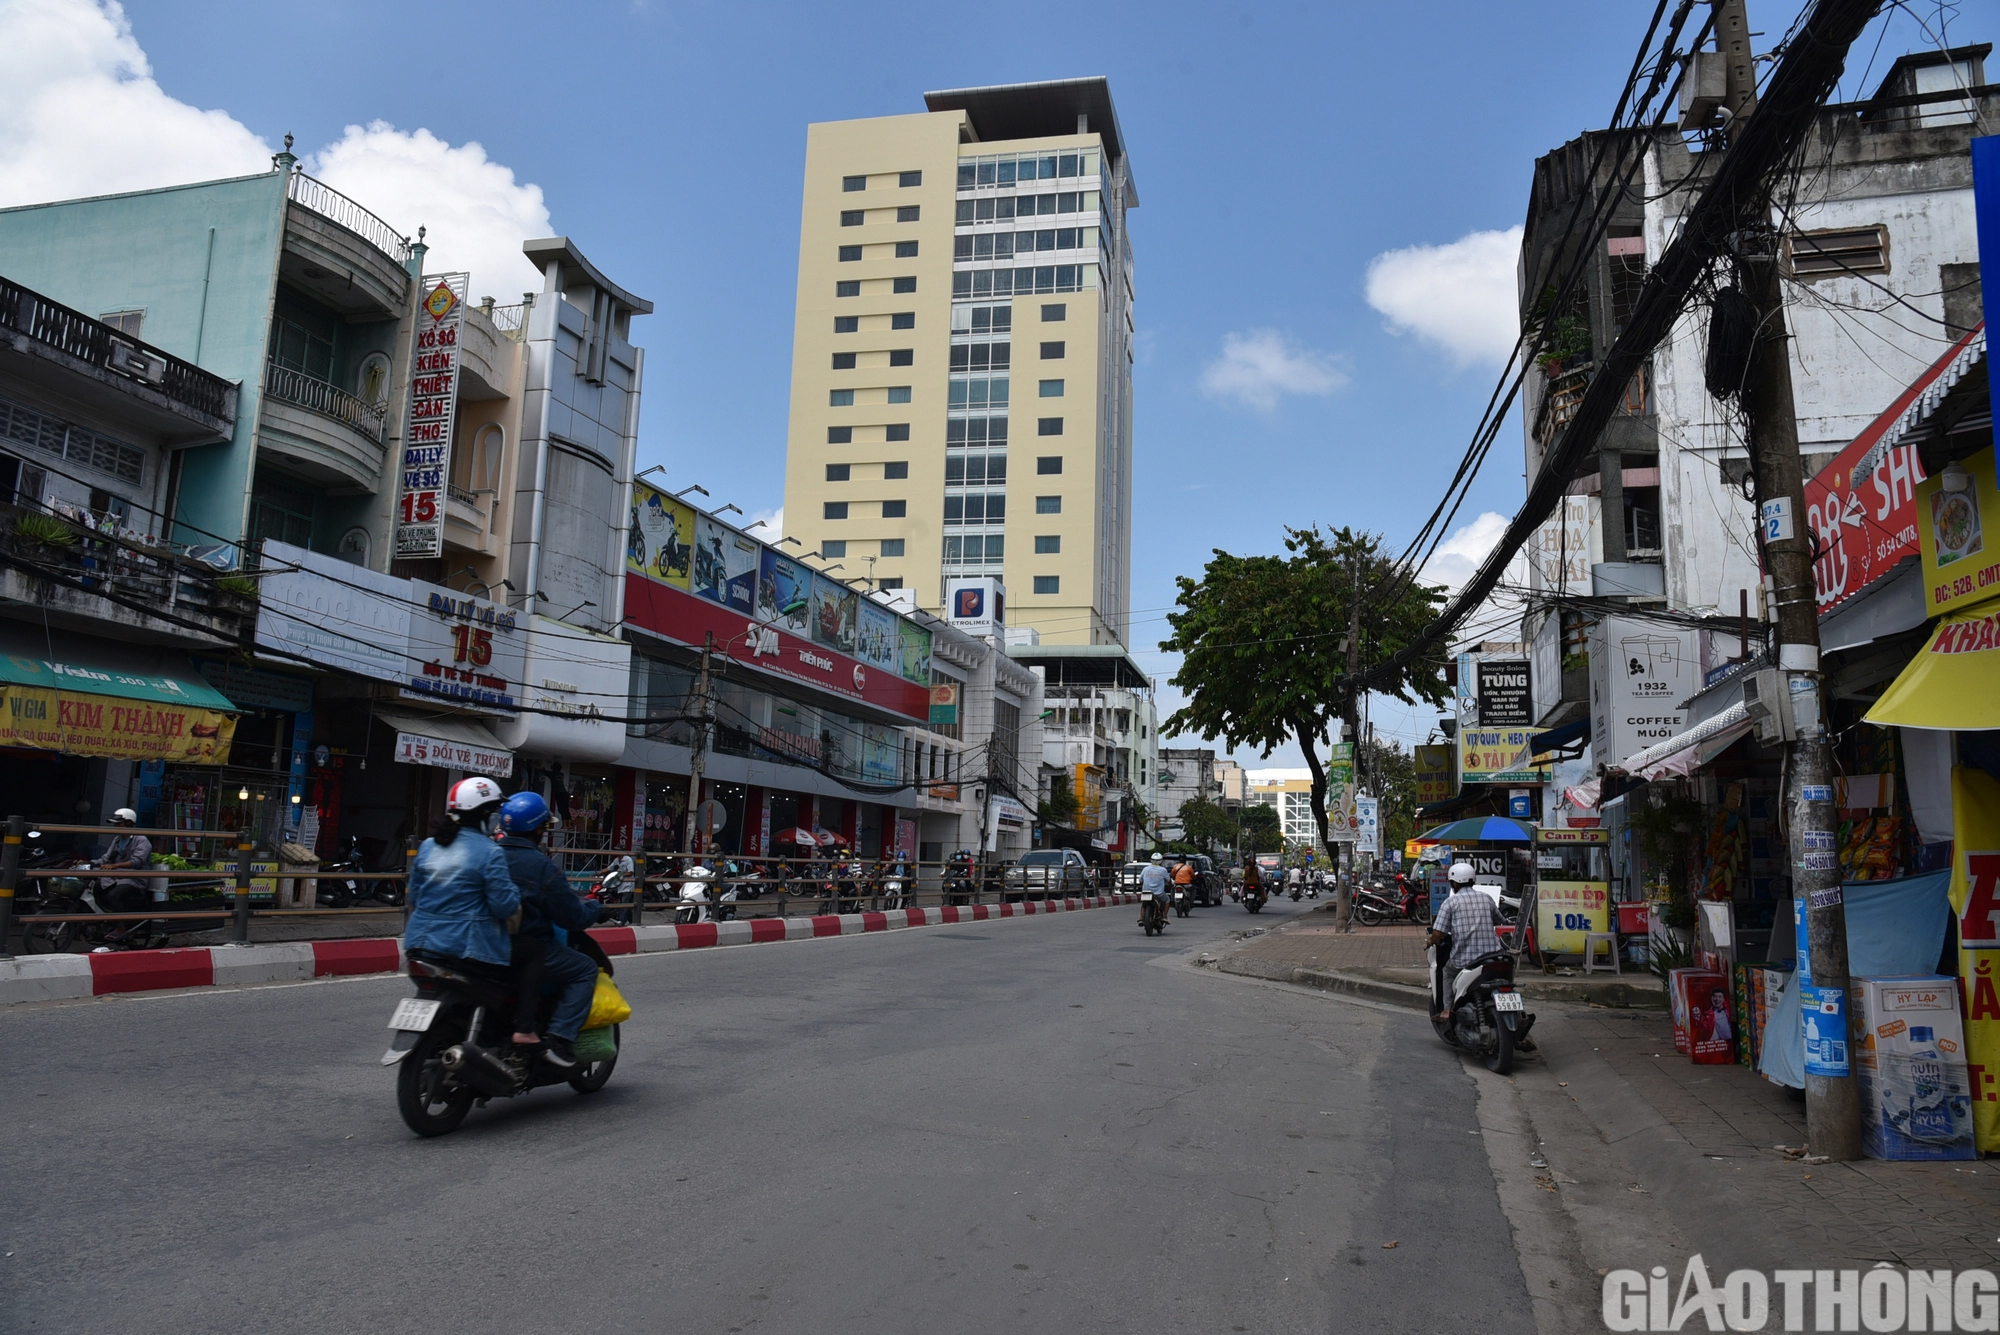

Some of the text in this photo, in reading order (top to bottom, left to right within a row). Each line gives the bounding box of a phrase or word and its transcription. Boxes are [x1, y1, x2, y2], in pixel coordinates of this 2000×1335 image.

[417, 348, 450, 370] KIẾN
[413, 372, 452, 394] THIẾT
[415, 396, 443, 417] CẦN
[401, 492, 438, 522] 15
[1877, 538, 1886, 561] SỐ
[732, 584, 750, 604] SCHOOL
[1935, 584, 1951, 604] ĐC:
[1953, 574, 1976, 598] 52B,
[428, 592, 456, 620] ĐẠI
[457, 599, 477, 622] LÝ
[477, 606, 496, 628] VÉ
[496, 610, 518, 634] SỐ
[316, 634, 332, 646] TRỌN
[451, 624, 492, 668] 15
[799, 650, 834, 672] THIÊN PHÚC
[42, 660, 111, 682] Vistra
[116, 675, 146, 686] 300
[1482, 673, 1527, 687] TÙNG
[10, 697, 186, 739] VỊ GIA KIM THÀNH
[67, 734, 82, 744] HEO
[1466, 732, 1524, 746] VỊT QUAY HEO
[1638, 727, 1672, 738] MUỐI
[401, 742, 510, 770] 15 ĐỔI VÉ TRÚNG
[1483, 749, 1506, 769] TÀI
[1418, 772, 1433, 782] QUAY
[1545, 829, 1599, 841] Cam Ép
[1539, 884, 1606, 910] CAM ÉP
[1554, 913, 1592, 931] 10k
[1898, 993, 1938, 1003] HY LẠP
[1940, 1040, 1956, 1051] MỚI
[1911, 1063, 1940, 1074] nutri
